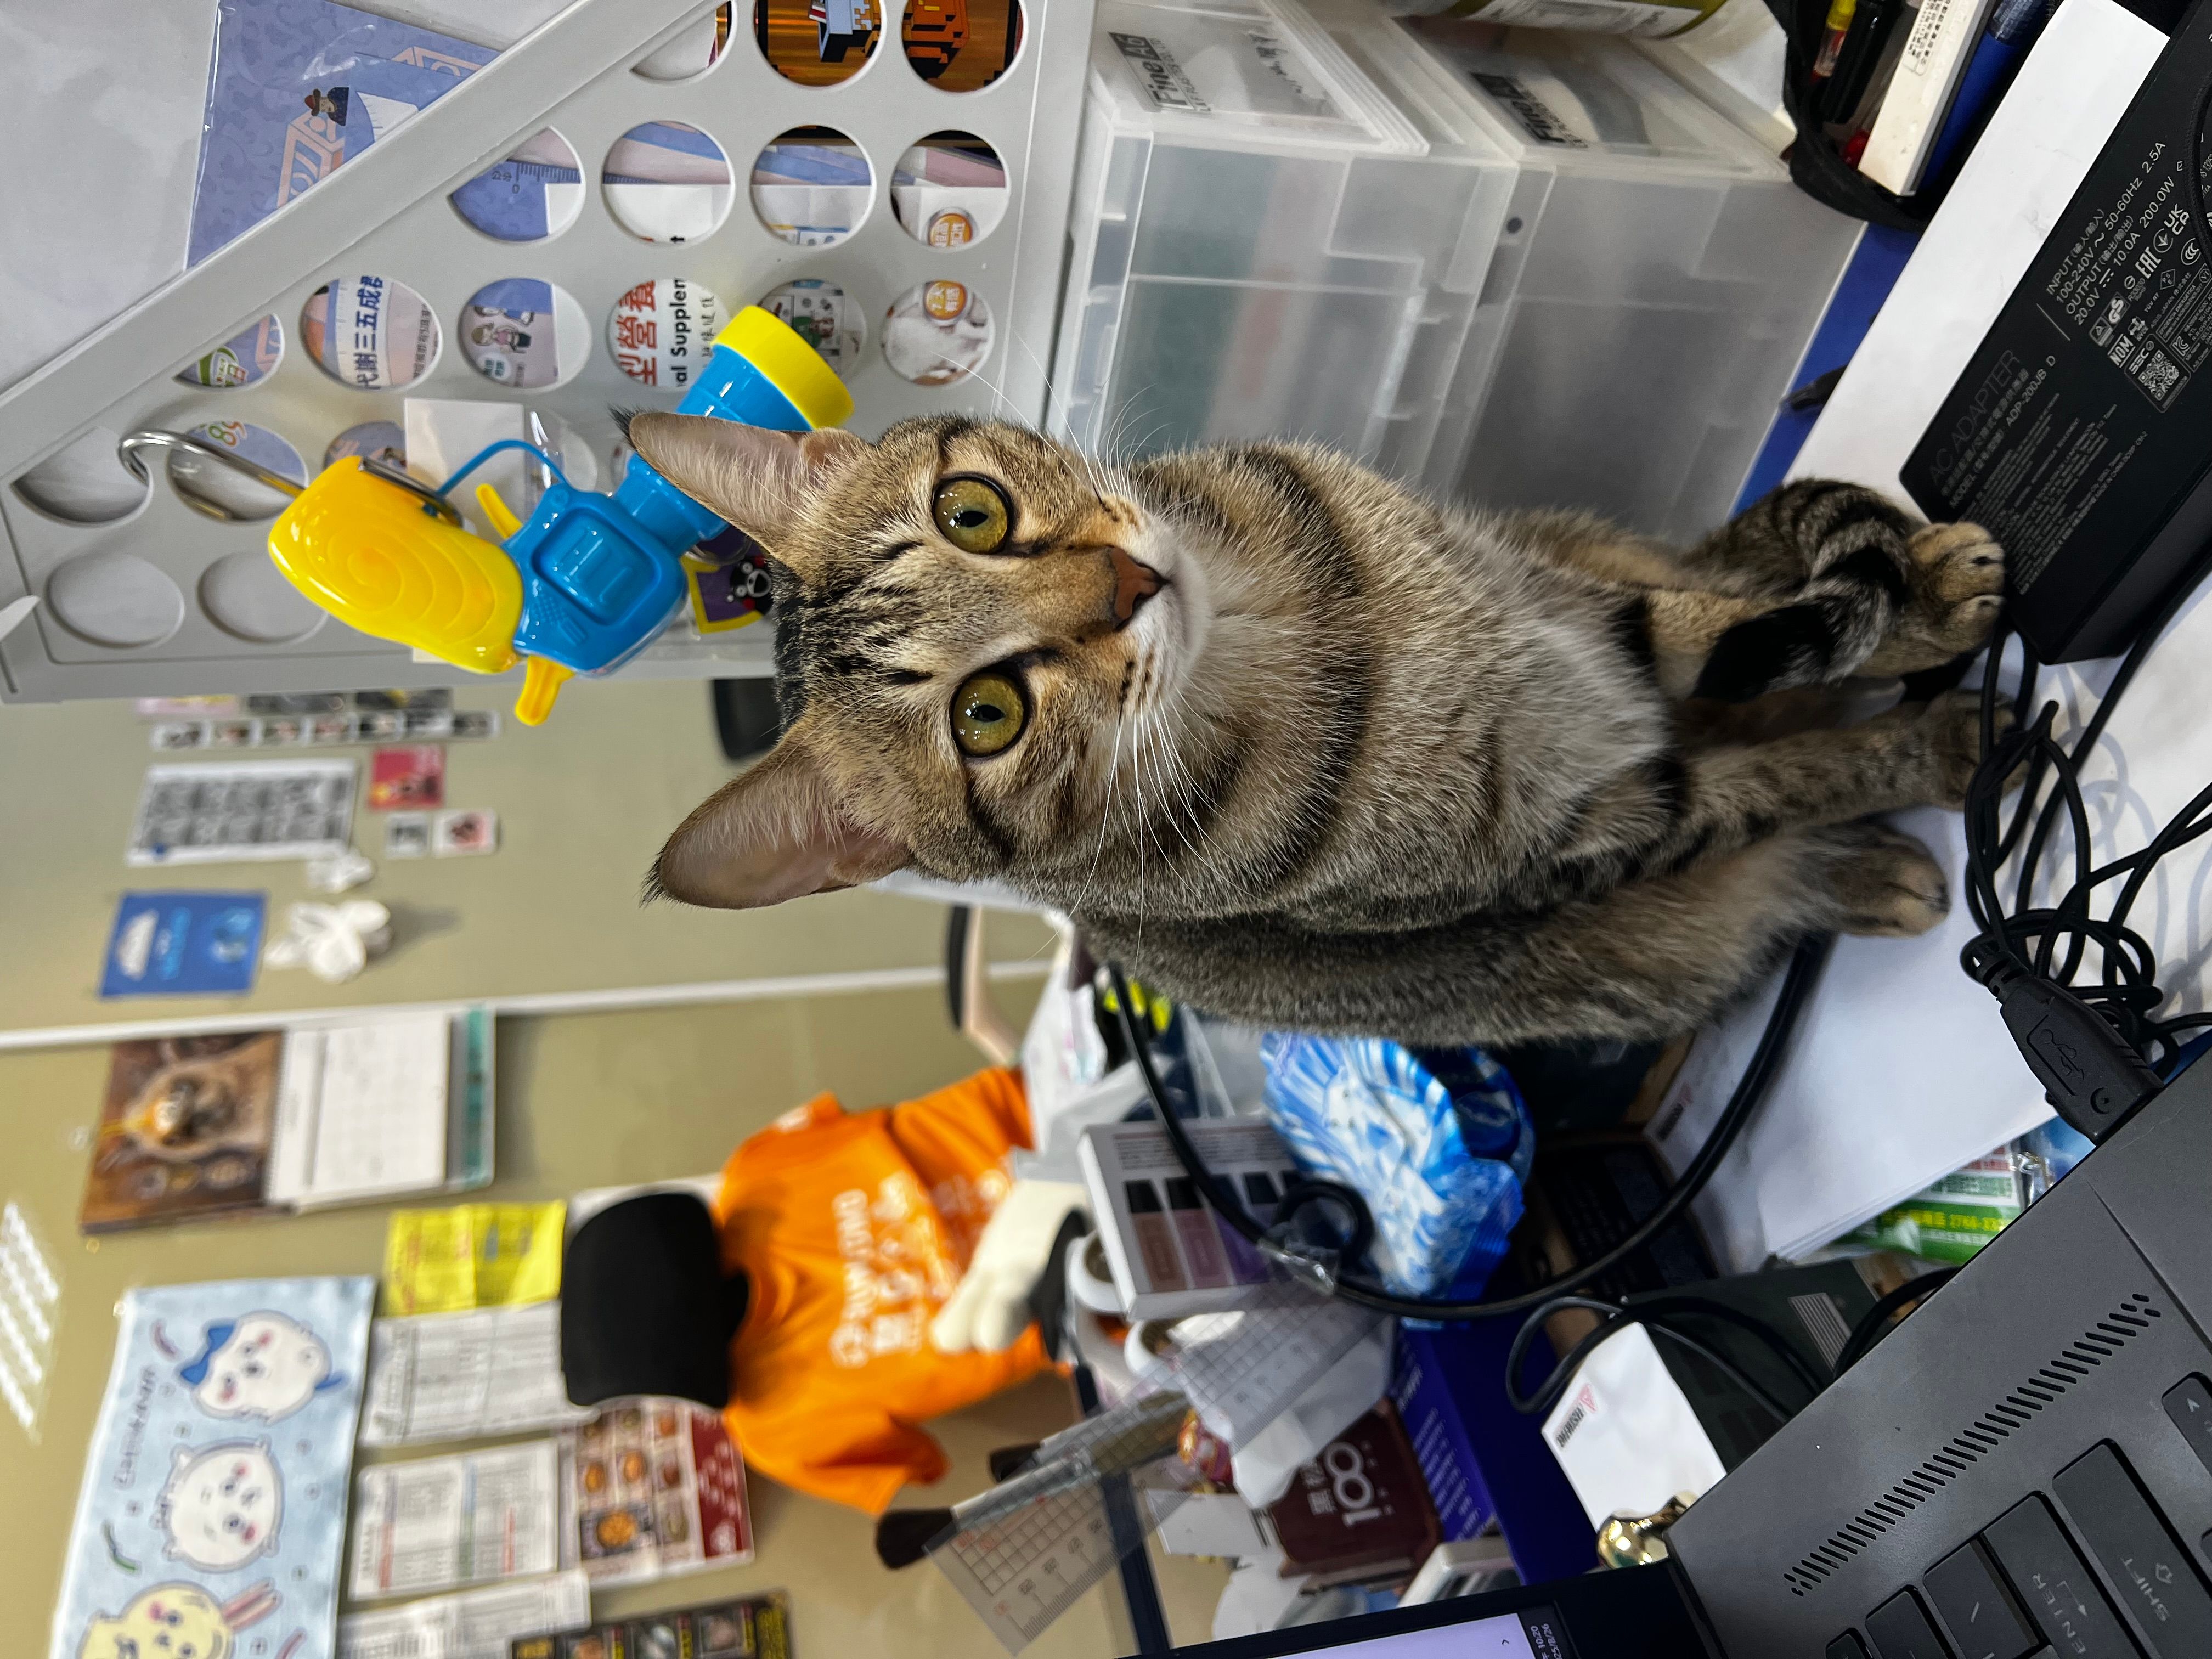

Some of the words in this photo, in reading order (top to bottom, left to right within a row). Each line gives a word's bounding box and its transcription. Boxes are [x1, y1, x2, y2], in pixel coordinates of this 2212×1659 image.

[1142, 61, 1188, 106] Fine
[2056, 247, 2094, 303] 100-240V
[2104, 178, 2142, 230] 50-60Hz
[2141, 143, 2165, 174] 2.5A
[2074, 288, 2100, 325] 20.0V
[2113, 233, 2140, 266] 10.0A
[2139, 176, 2174, 229] 200.0W
[670, 365, 687, 386] al
[2045, 356, 2056, 367] D
[2109, 336, 2133, 366] NOM
[1951, 350, 2020, 452] ADAPTER
[2032, 1572, 2086, 1653] ENTER
[2121, 1555, 2171, 1622] SHIFT
[1541, 1623, 1562, 1659] 25/8/26
